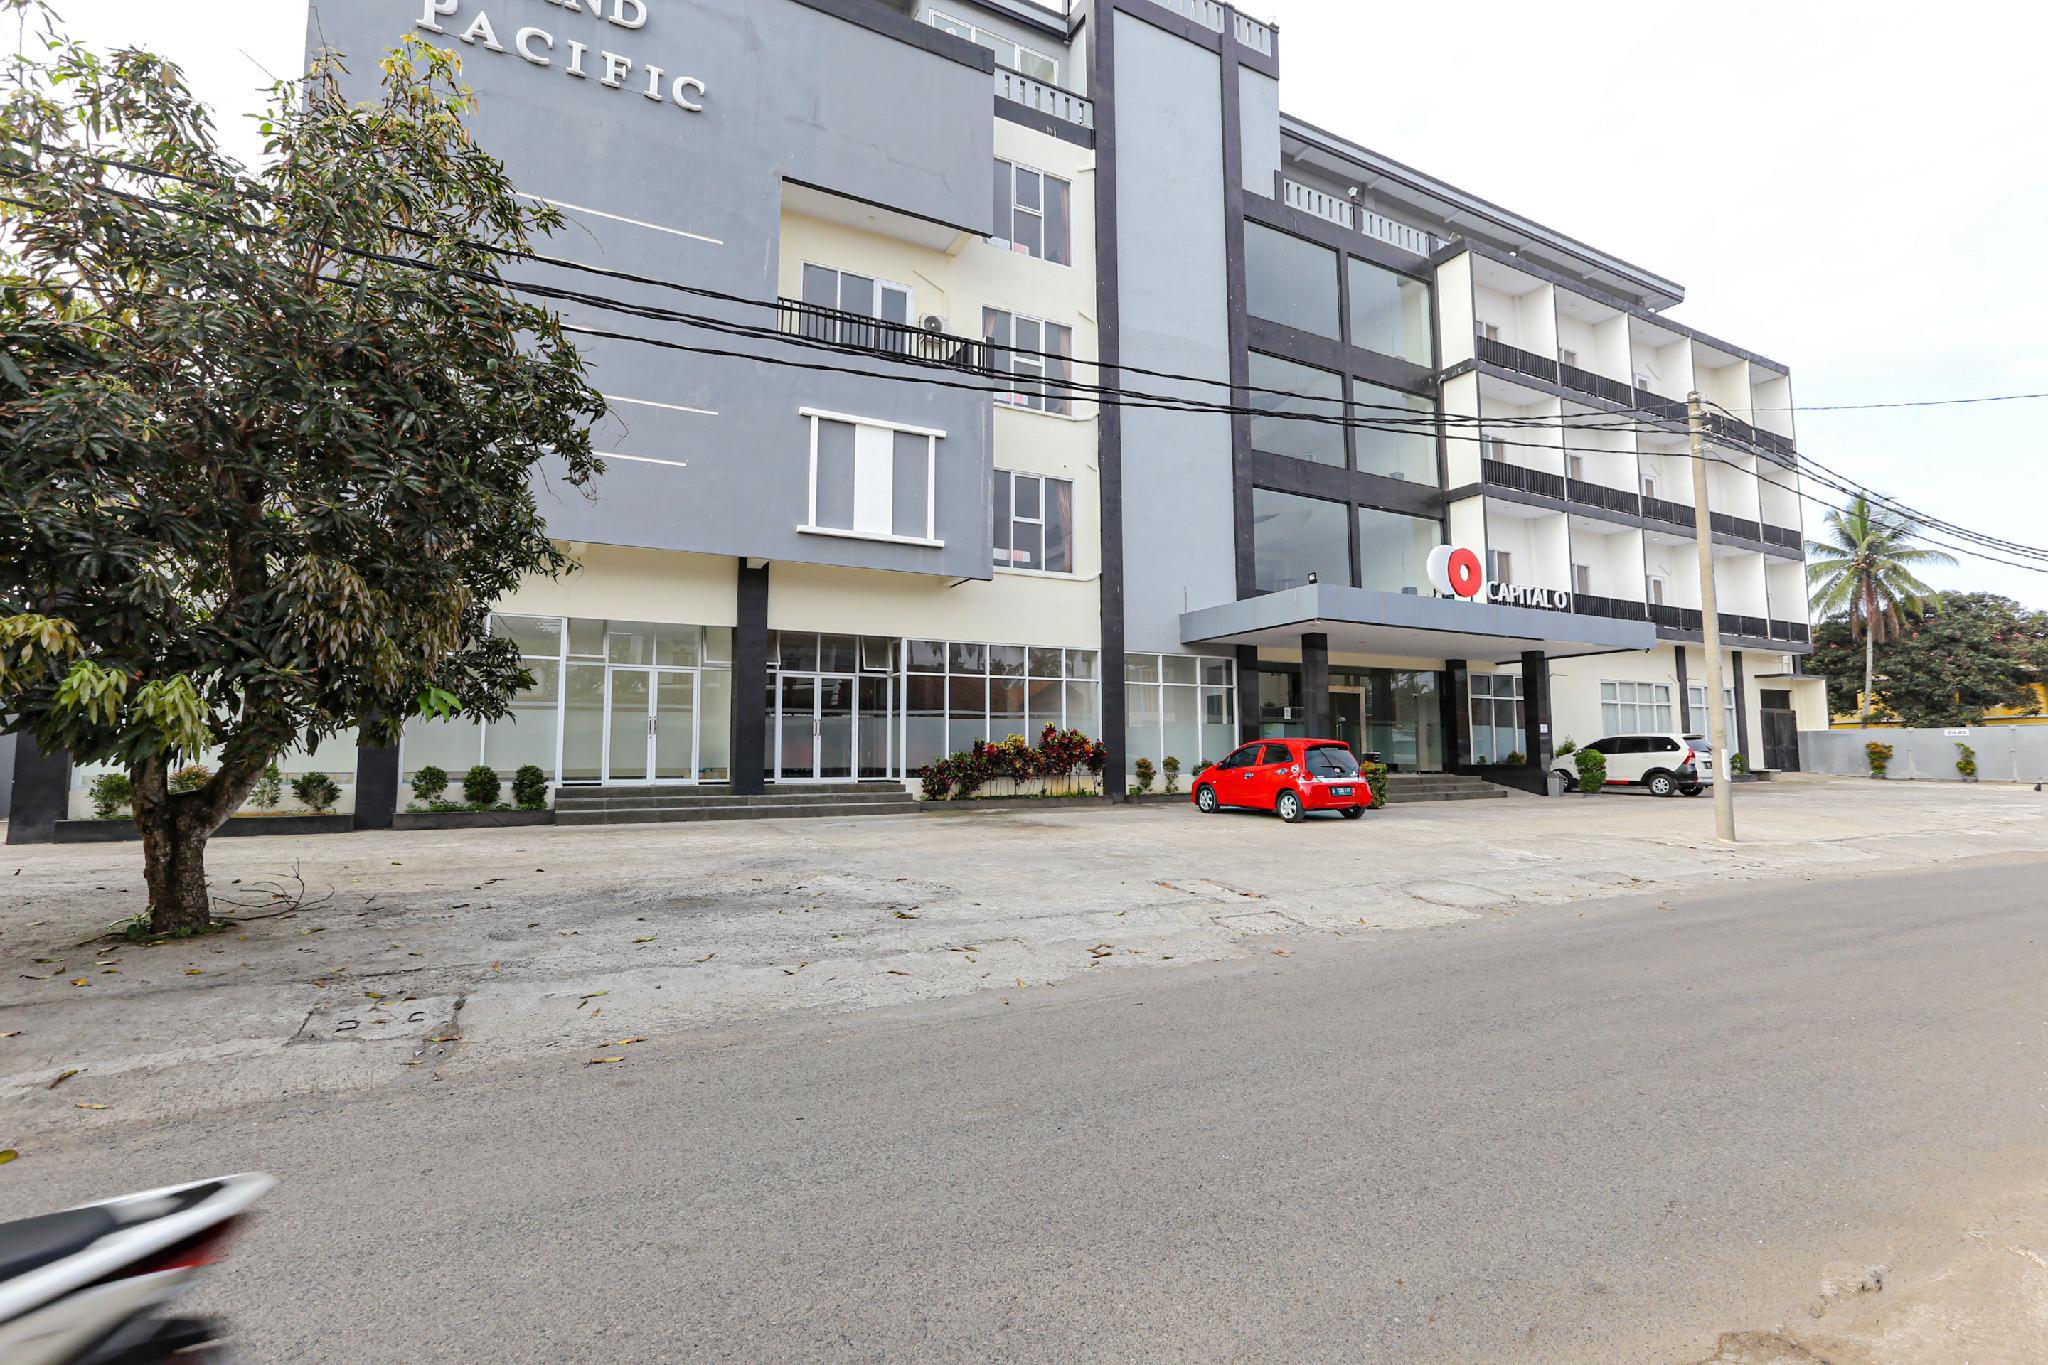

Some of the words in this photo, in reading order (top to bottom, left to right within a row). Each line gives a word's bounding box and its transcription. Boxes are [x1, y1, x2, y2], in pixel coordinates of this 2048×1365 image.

[416, 0, 705, 111] PACIFIC
[1487, 581, 1552, 608] CAPITAL
[1553, 591, 1568, 609] O
